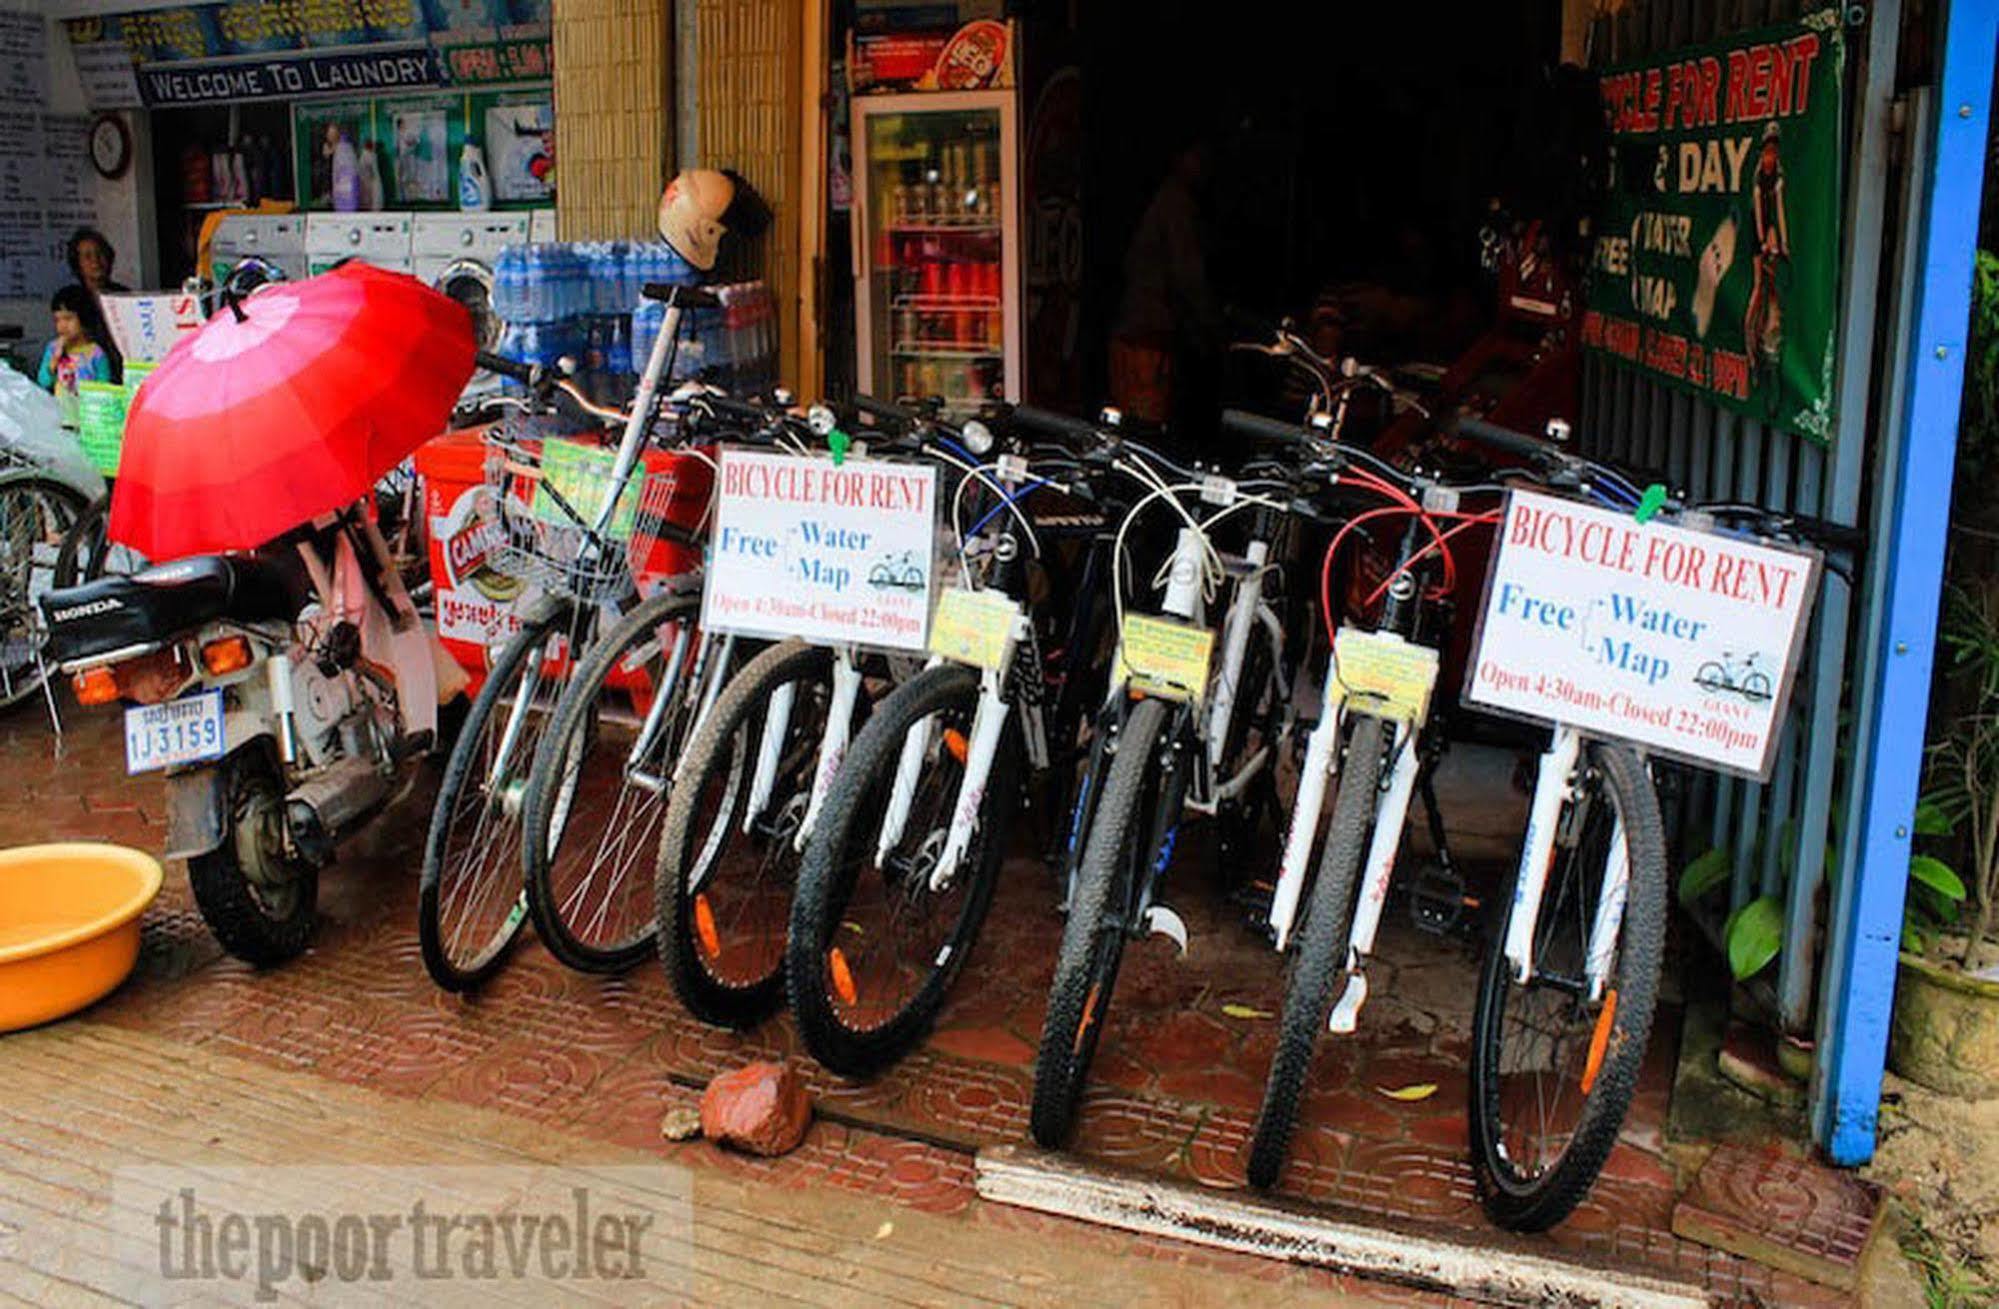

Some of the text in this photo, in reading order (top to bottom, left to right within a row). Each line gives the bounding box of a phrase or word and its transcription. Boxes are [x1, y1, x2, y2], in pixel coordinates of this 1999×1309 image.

[150, 69, 263, 101] WELCOME
[311, 57, 430, 90] LAUNDRY
[1663, 58, 1721, 130] FOR
[1725, 33, 1819, 124] RENT
[1678, 136, 1753, 194] DAY
[723, 461, 929, 513] BICYCLE FOR RENT
[721, 526, 779, 558] Free
[800, 520, 872, 552] Water
[1509, 504, 1798, 610] BICYCLE FOR RENT
[799, 557, 851, 593] Map
[53, 597, 124, 623] HONDA
[1498, 583, 1575, 631] Free
[1610, 592, 1708, 642] Water
[1600, 637, 1670, 686] Map
[1480, 660, 1539, 695] Open
[1675, 709, 1760, 750] 22:00pm
